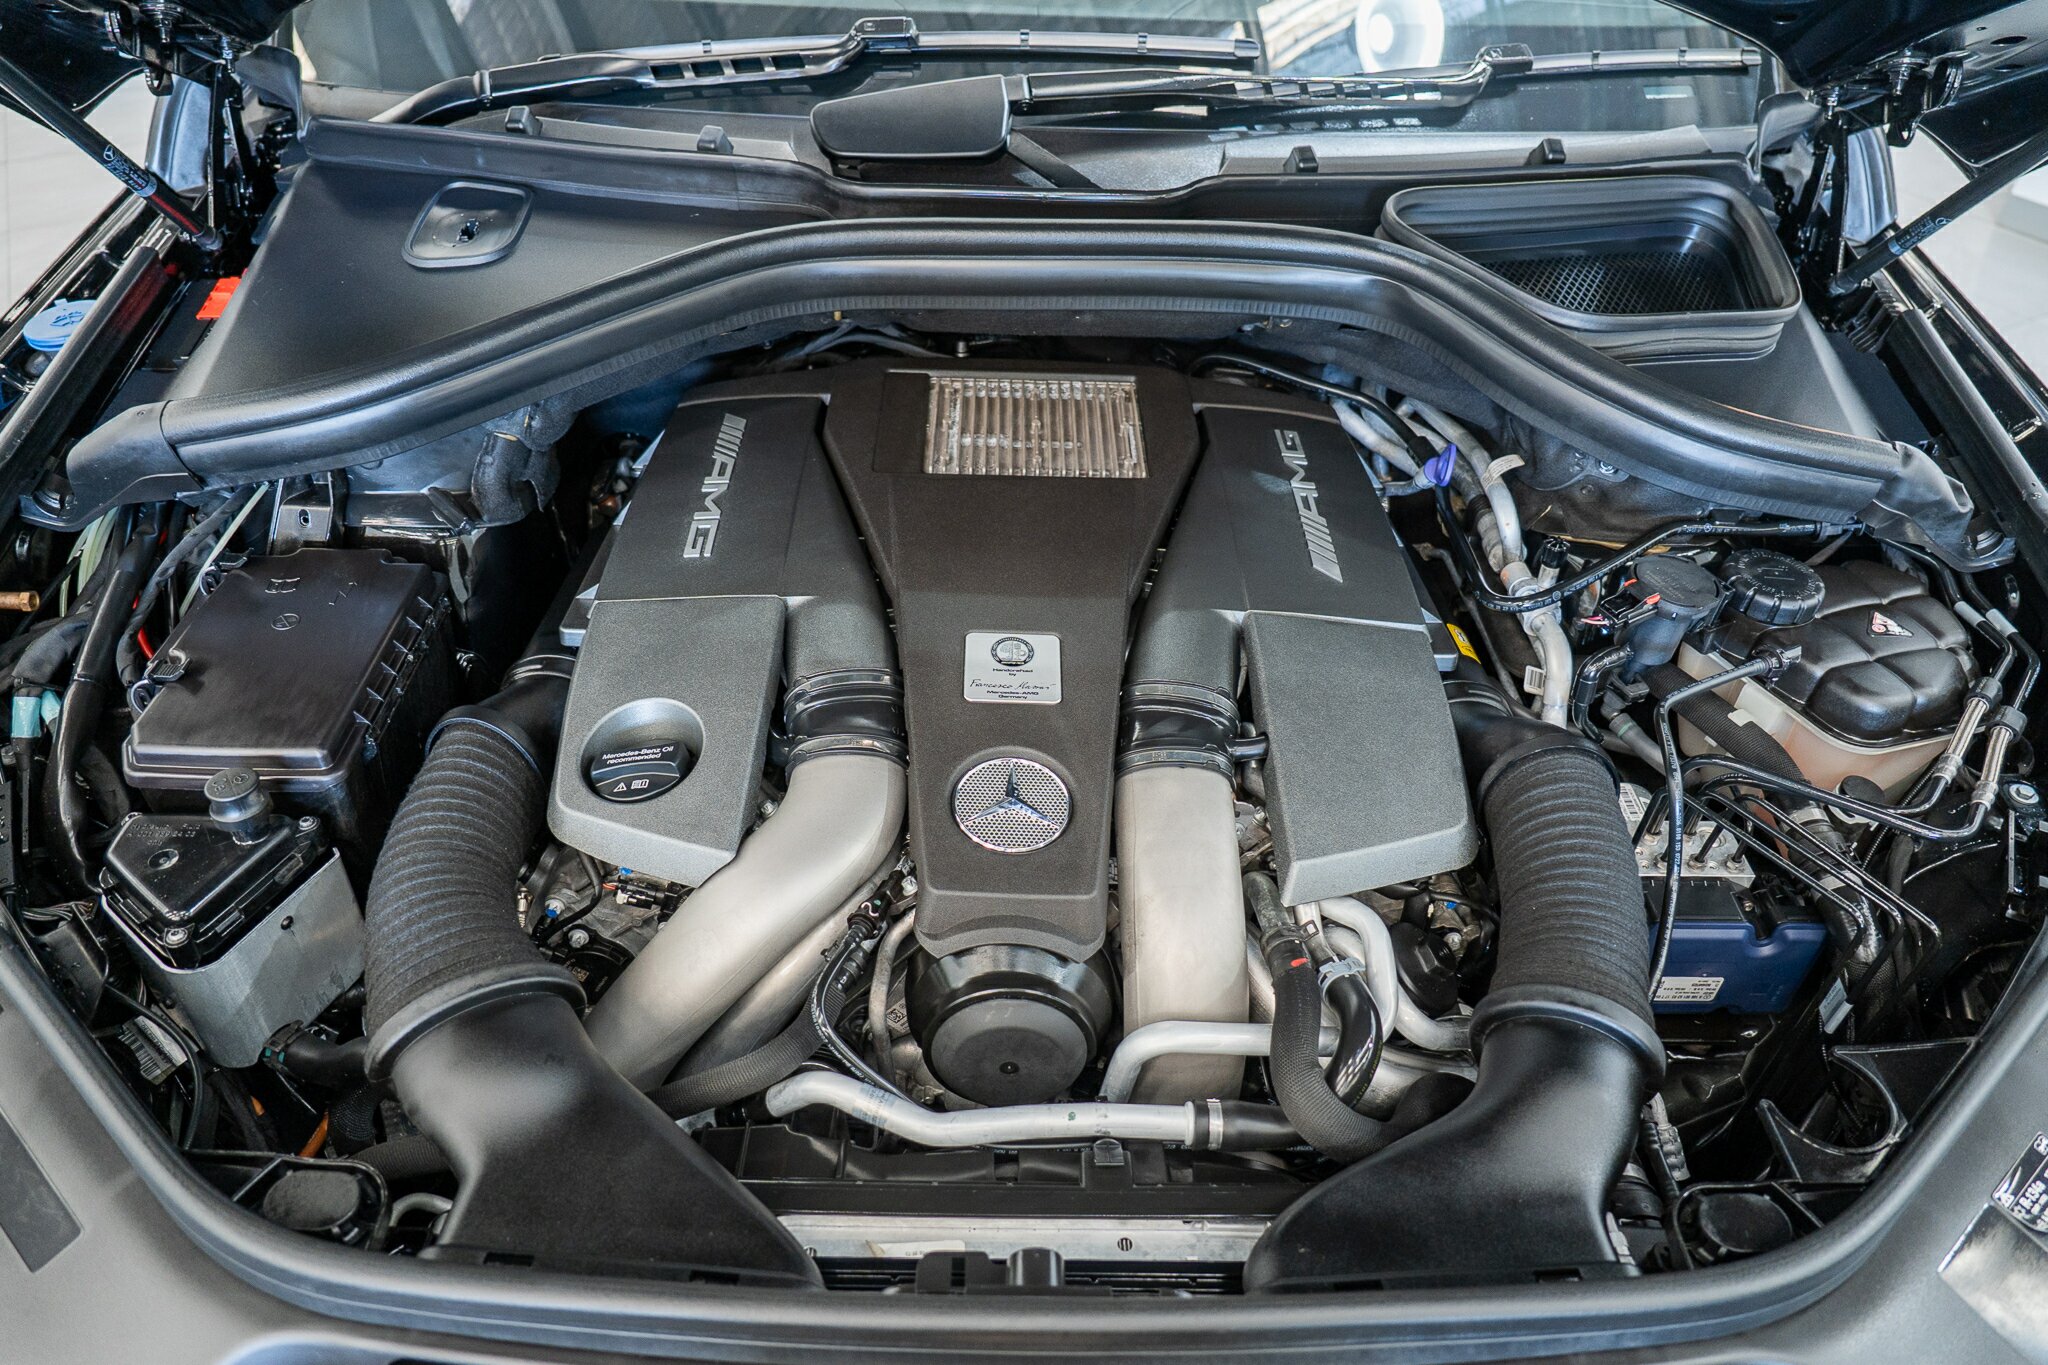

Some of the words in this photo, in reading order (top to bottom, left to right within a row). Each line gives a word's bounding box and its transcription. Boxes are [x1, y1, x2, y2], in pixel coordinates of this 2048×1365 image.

[683, 450, 735, 558] AMG
[1274, 429, 1329, 530] AMG
[602, 748, 661, 760] Mercedes-Benz
[607, 753, 662, 764] recommended
